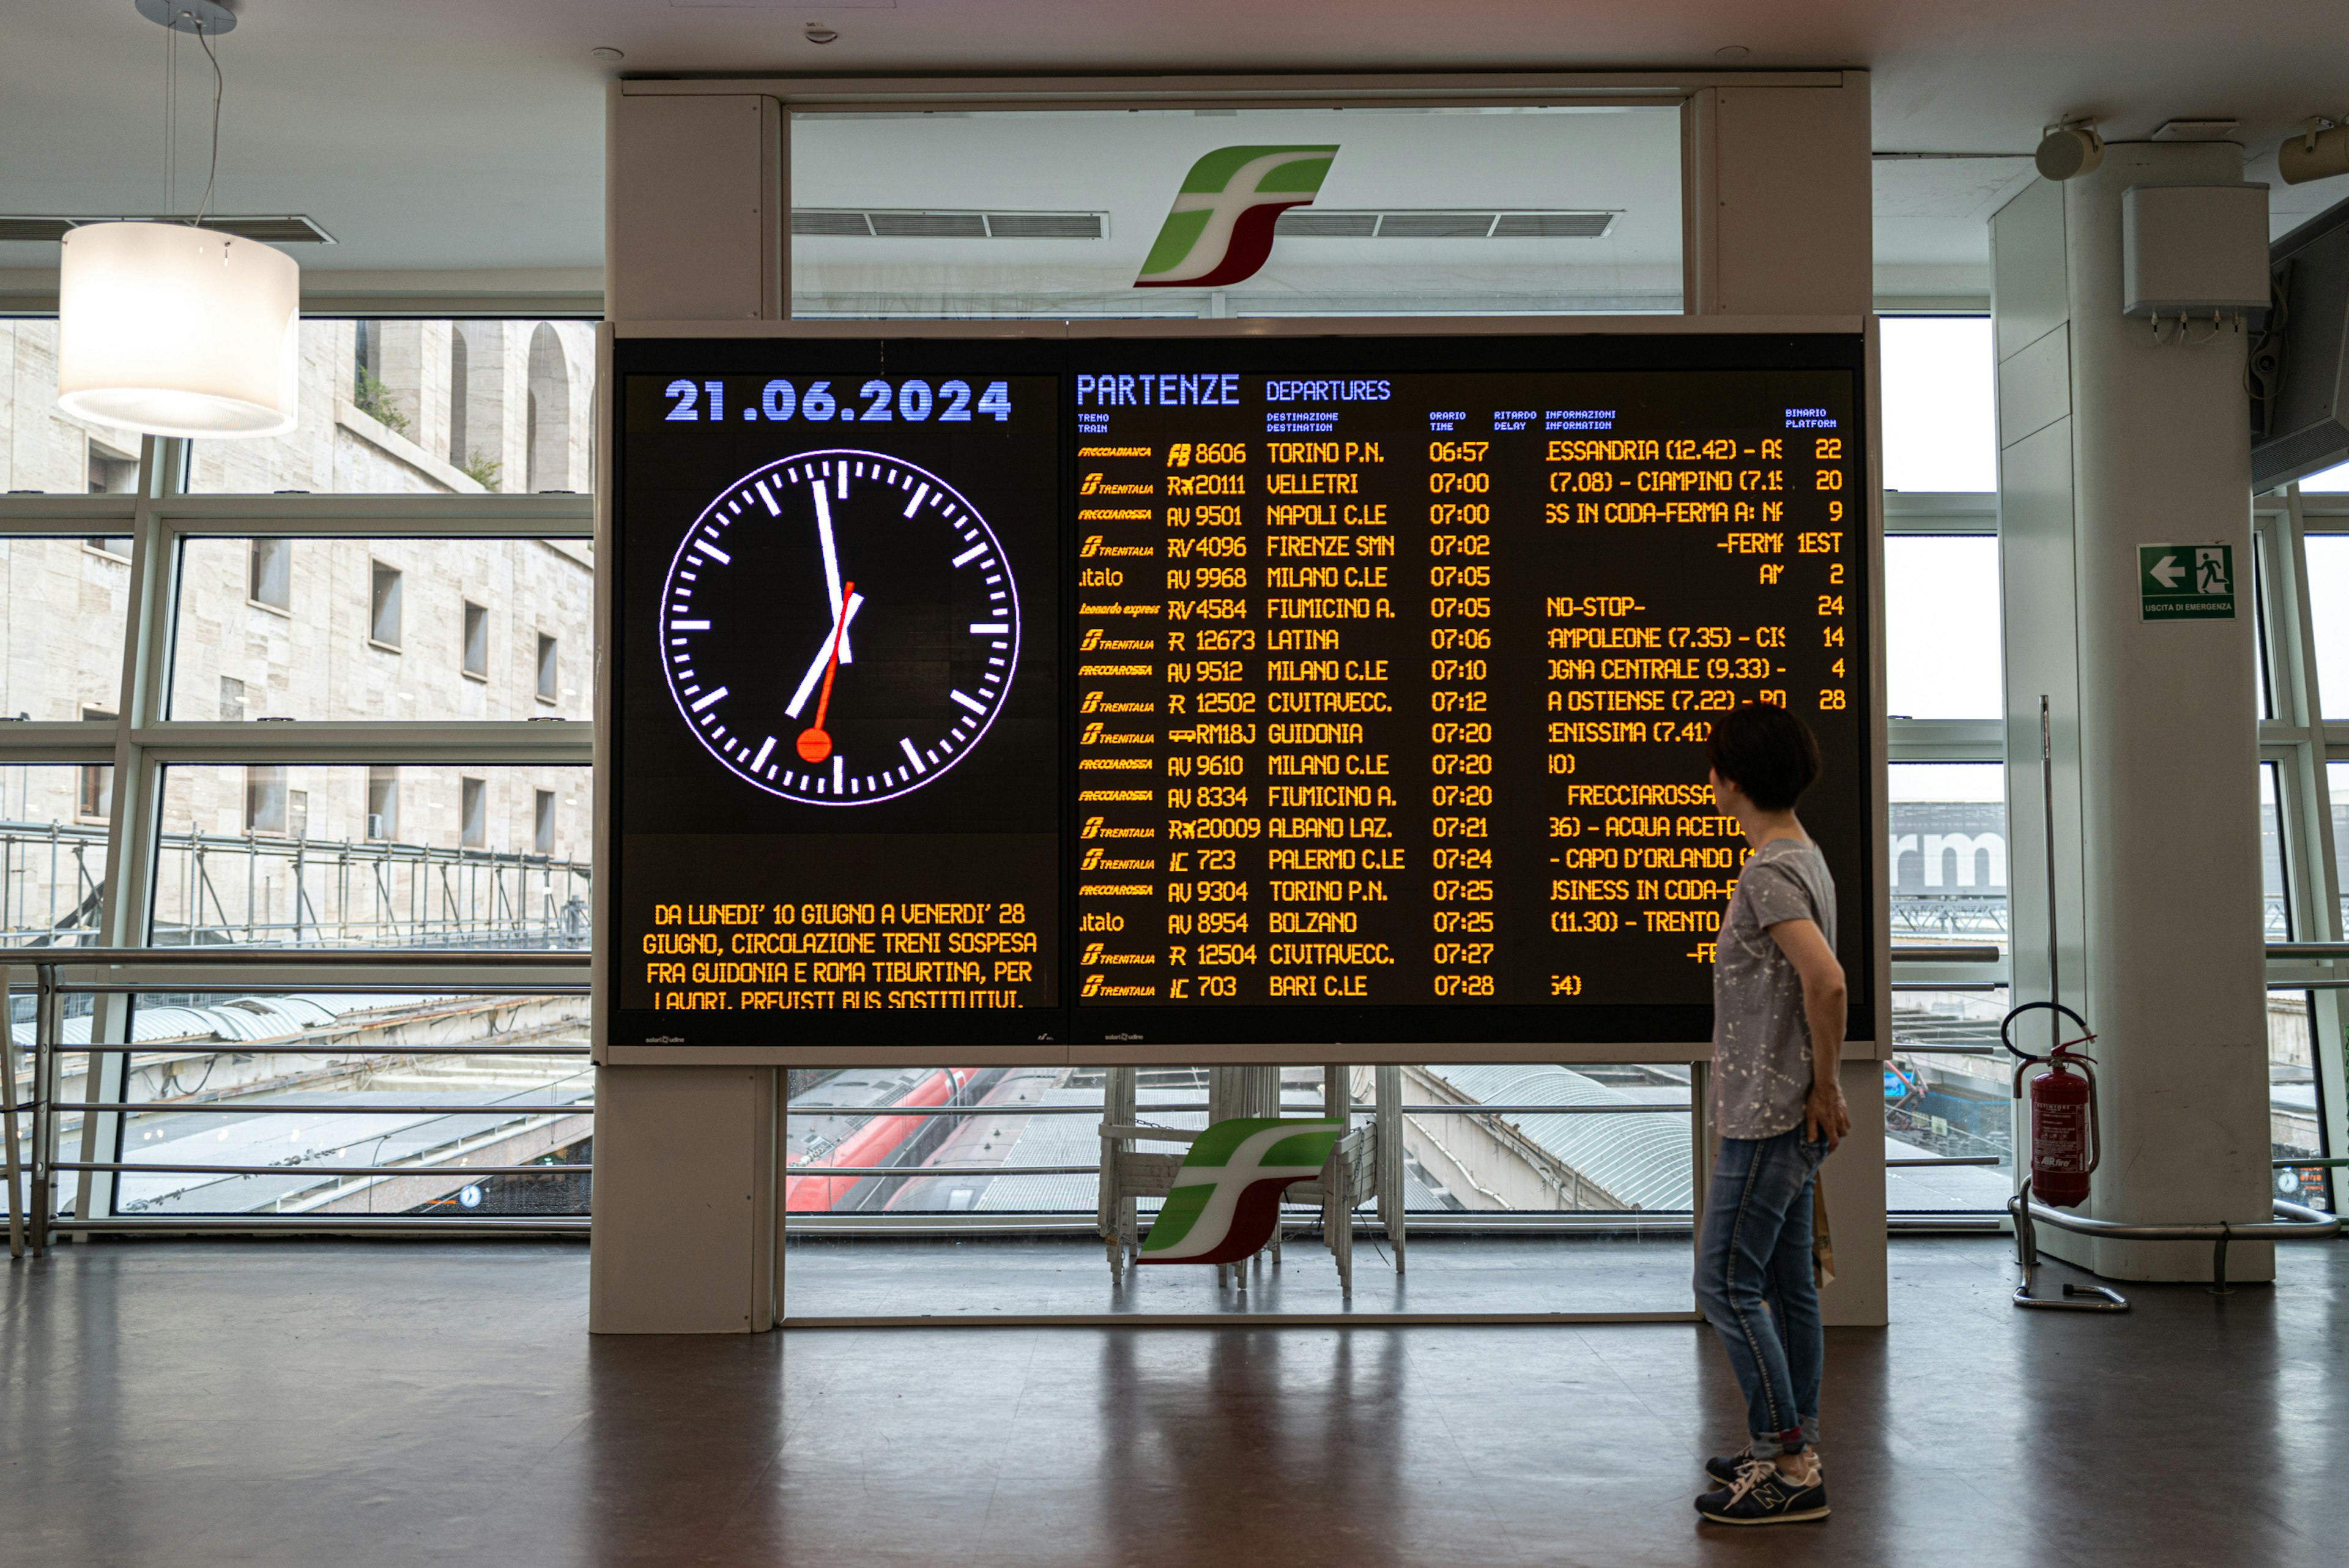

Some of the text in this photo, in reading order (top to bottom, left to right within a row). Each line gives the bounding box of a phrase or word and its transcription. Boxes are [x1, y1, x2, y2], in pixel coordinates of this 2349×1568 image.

[1077, 374, 1239, 405] PARTENZE
[1266, 380, 1390, 401] DEPARTURES
[665, 379, 1011, 422] 21.06.2024
[1078, 414, 1109, 422] TRENO
[1266, 412, 1338, 421] DESTINAZIONE
[1429, 411, 1466, 420] ORARIO
[1494, 411, 1537, 420] RITARDO
[1545, 411, 1616, 419] INFORMAZIONI
[1786, 409, 1827, 417] BINARIO
[1266, 423, 1333, 432] DESTINATION
[1430, 422, 1453, 431] TIME
[1494, 422, 1526, 431] DELAY
[1545, 421, 1612, 430] INFORMATION
[1786, 419, 1836, 428] PLATFORM
[1195, 444, 1246, 464] 8606
[1267, 442, 1384, 463] TORINO P.N.
[1430, 442, 1489, 462] 06:57
[1666, 439, 1736, 460] (12.42)
[1816, 438, 1841, 459] 22
[1099, 485, 1153, 494] TRENITALIA
[1267, 474, 1358, 494] VELLETRI
[1430, 473, 1489, 493] 07:00
[1550, 471, 1732, 492] (7.08) CIAMPINO
[1816, 470, 1842, 490] 20
[1078, 510, 1151, 520] FRECCIAROSSA
[1167, 506, 1242, 527] AV 9501
[1267, 505, 1387, 525] NAPOLI C.LE
[1430, 504, 1490, 524] 07:00
[1577, 502, 1728, 523] IN CODA-FERMA
[1829, 501, 1842, 521] 9
[1099, 546, 1154, 557] TRENITALIA
[1267, 535, 1395, 557] FIRENZE SMN
[1430, 535, 1490, 555] 07:02
[1798, 532, 1842, 553] 1EST
[1167, 568, 1247, 589] AV 9968
[1267, 567, 1387, 587] MILANO C.LE
[1430, 567, 1490, 587] 07:05
[1830, 563, 1844, 584] 2
[1079, 602, 1160, 617] Leonardo express
[1267, 598, 1395, 619] FIUMICINO A.
[1431, 598, 1490, 618] 07:05
[1547, 596, 1646, 617] NO-STOP-
[1818, 595, 1844, 615] 24
[2185, 603, 2232, 611] EMERGENZA
[1099, 641, 1154, 650] TRENITALIA
[1197, 630, 1255, 650] 12673
[1267, 630, 1338, 650] LATINA
[1431, 629, 1491, 649] 07:06
[1668, 627, 1731, 647] (7.35)
[1824, 626, 1844, 647] 14
[1078, 665, 1152, 675] FRECCIAROSSA
[1167, 661, 1243, 683] AV 9512
[1268, 660, 1388, 681] MILANO C.LE
[1431, 660, 1486, 680] 07:10
[1601, 658, 1770, 679] CENTRALE (9.33)
[1831, 658, 1845, 678] 4
[1099, 703, 1154, 713] TRENITALIA
[1197, 693, 1255, 713] 12502
[1268, 692, 1392, 712] CIVITAVECC.
[1431, 691, 1486, 712] 07:12
[1568, 690, 1735, 711] OSTIENSE (7.22)
[1820, 689, 1846, 710] 28
[1099, 734, 1154, 744] TRENITALIA
[1268, 723, 1363, 744] GUIDONIA
[1432, 723, 1491, 743] 07:20
[1079, 759, 1152, 770] FRECCIAROSSA
[1168, 755, 1243, 777] AV 9610
[1268, 754, 1389, 775] MILANO C.LE
[1432, 754, 1492, 775] 07:20
[1078, 790, 1152, 801] FRECCIAROSSA
[1168, 786, 1248, 808] AV 8334
[1269, 786, 1397, 806] FIUMICINO A.
[1432, 786, 1492, 806] 07:20
[1568, 786, 1716, 806] FRECCIAROSSA
[1099, 828, 1154, 838] TRENITALIA
[1269, 817, 1392, 838] ALBANO LAZ.
[1433, 817, 1488, 838] 07:21
[1605, 817, 1670, 837] ACQUA
[1099, 860, 1154, 869] TRENITALIA
[1197, 849, 1236, 870] 723
[1269, 849, 1405, 869] PALERMO C.LE
[1433, 849, 1493, 869] 07:24
[1566, 849, 1618, 869] CAPO
[1624, 848, 1732, 869] D'ORLANDO
[1079, 885, 1153, 896] FRECCIAROSSA
[1168, 881, 1248, 903] AV 9304
[1269, 881, 1387, 901] TORINO P.N.
[1433, 880, 1493, 901] 07:25
[1636, 880, 1658, 900] IN
[655, 903, 1025, 924] DA LUNEDI' 10 GIUGNO A VENERDI' 28
[1168, 912, 1249, 935] AV 8954
[1269, 912, 1357, 932] BOLZANO
[1433, 912, 1494, 932] 07:25
[1551, 911, 1720, 932] (11.30) TRENTO
[644, 932, 1037, 956] GIUGNO, CIRCOLAZIONE TRENI SOSPESA
[1197, 944, 1257, 964] 12504
[1269, 943, 1394, 964] CIVITAVECC.
[1434, 943, 1494, 964] 07:27
[1099, 954, 1155, 964] TRENITALIA
[647, 961, 1032, 984] FRA GUIDONIA E ROMA TIBURTINA, PER
[1099, 986, 1155, 996] TRENITALIA
[1198, 976, 1236, 996] 703
[1270, 975, 1367, 996] BARI C.LE
[1434, 975, 1494, 995] 07:28
